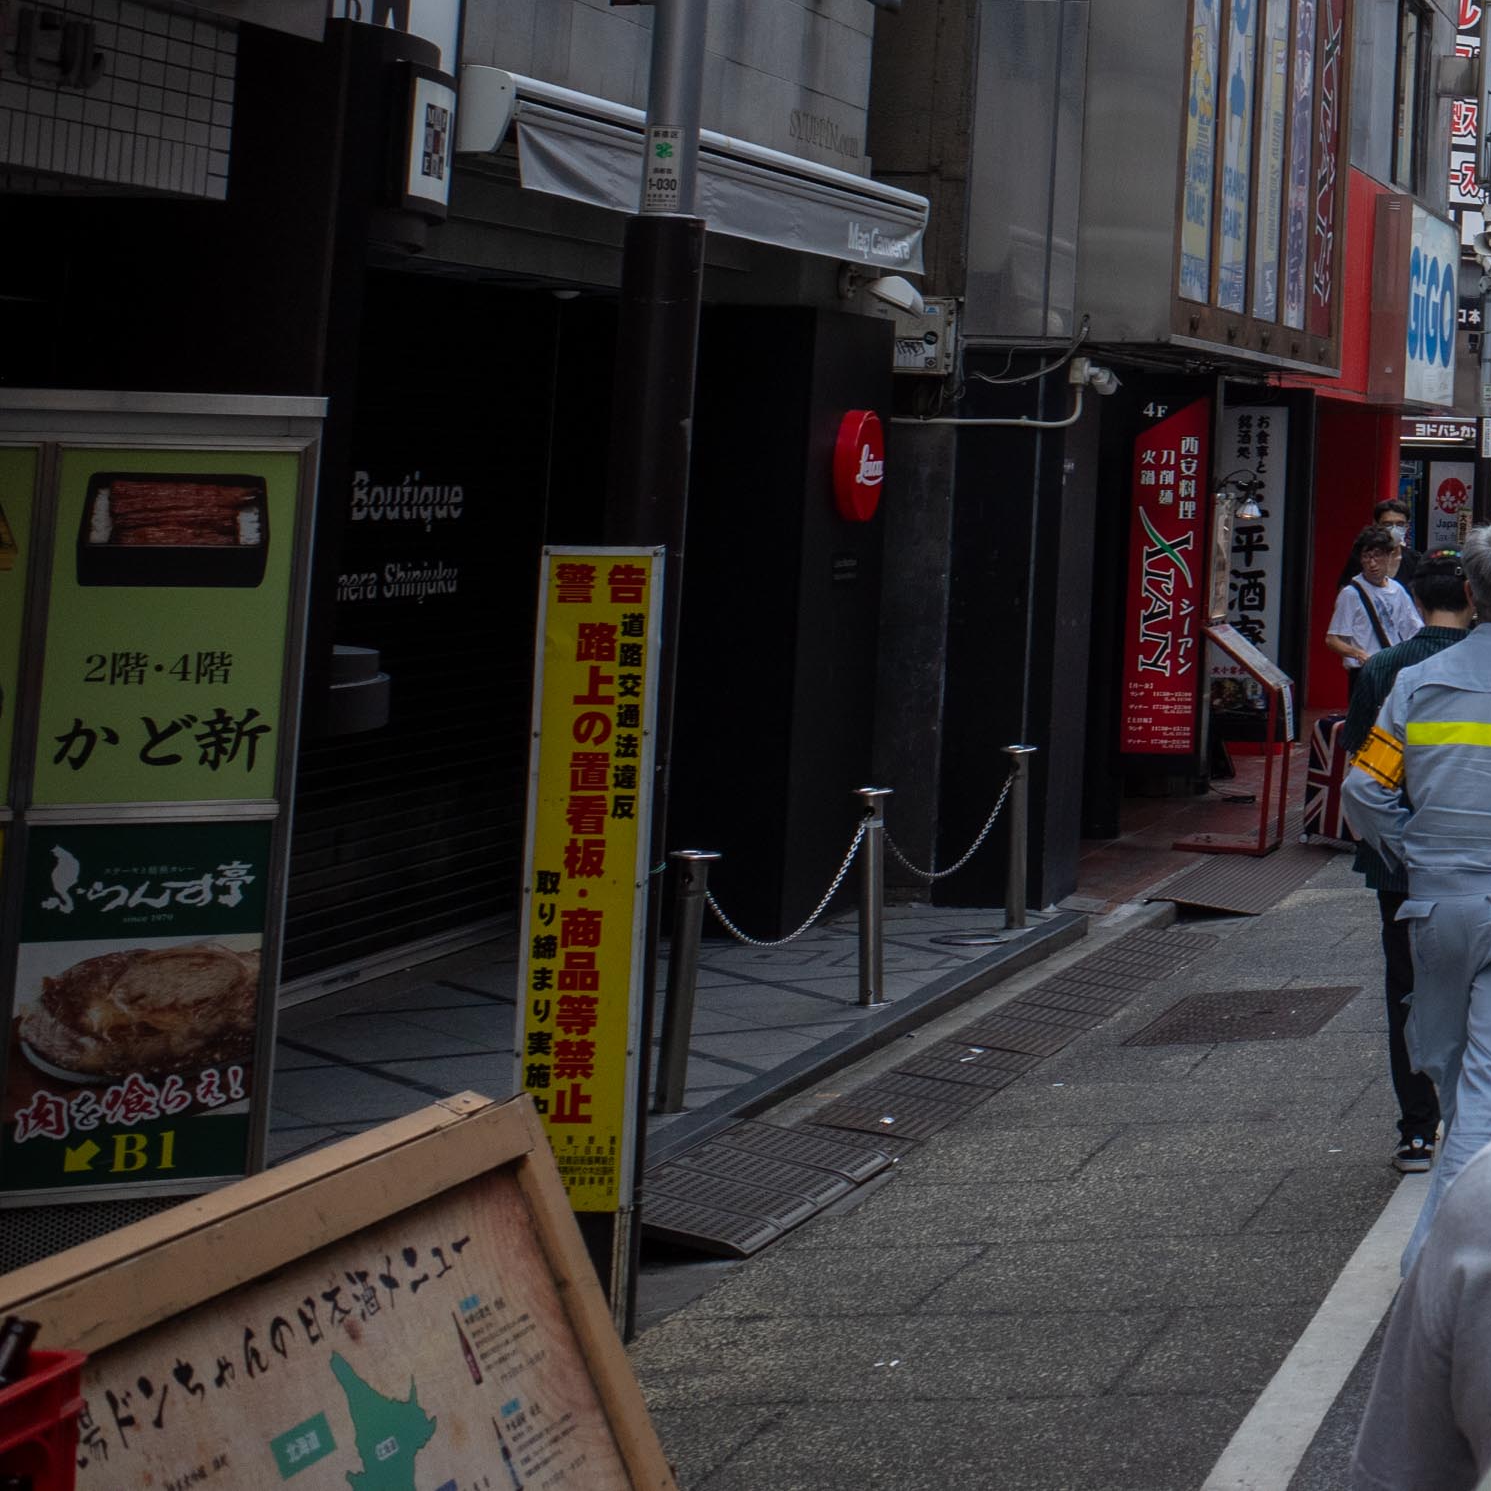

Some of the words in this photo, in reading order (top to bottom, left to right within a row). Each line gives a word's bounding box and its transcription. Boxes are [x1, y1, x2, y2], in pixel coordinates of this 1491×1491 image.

[1142, 401, 1168, 418] 4F
[1140, 449, 1157, 486] 火鍋
[1255, 414, 1269, 475] お食事と
[351, 470, 464, 531] Boutique
[1158, 449, 1176, 506] 刀削麺
[1178, 436, 1200, 520] 西安料理
[383, 560, 458, 604] Shinjuku
[555, 563, 647, 604] 警告
[1176, 598, 1195, 676] シーアン
[83, 651, 234, 686] 2階・4階
[53, 707, 273, 772] かど新
[611, 613, 646, 819] 道路交通法違反
[110, 1130, 177, 1173] B1
